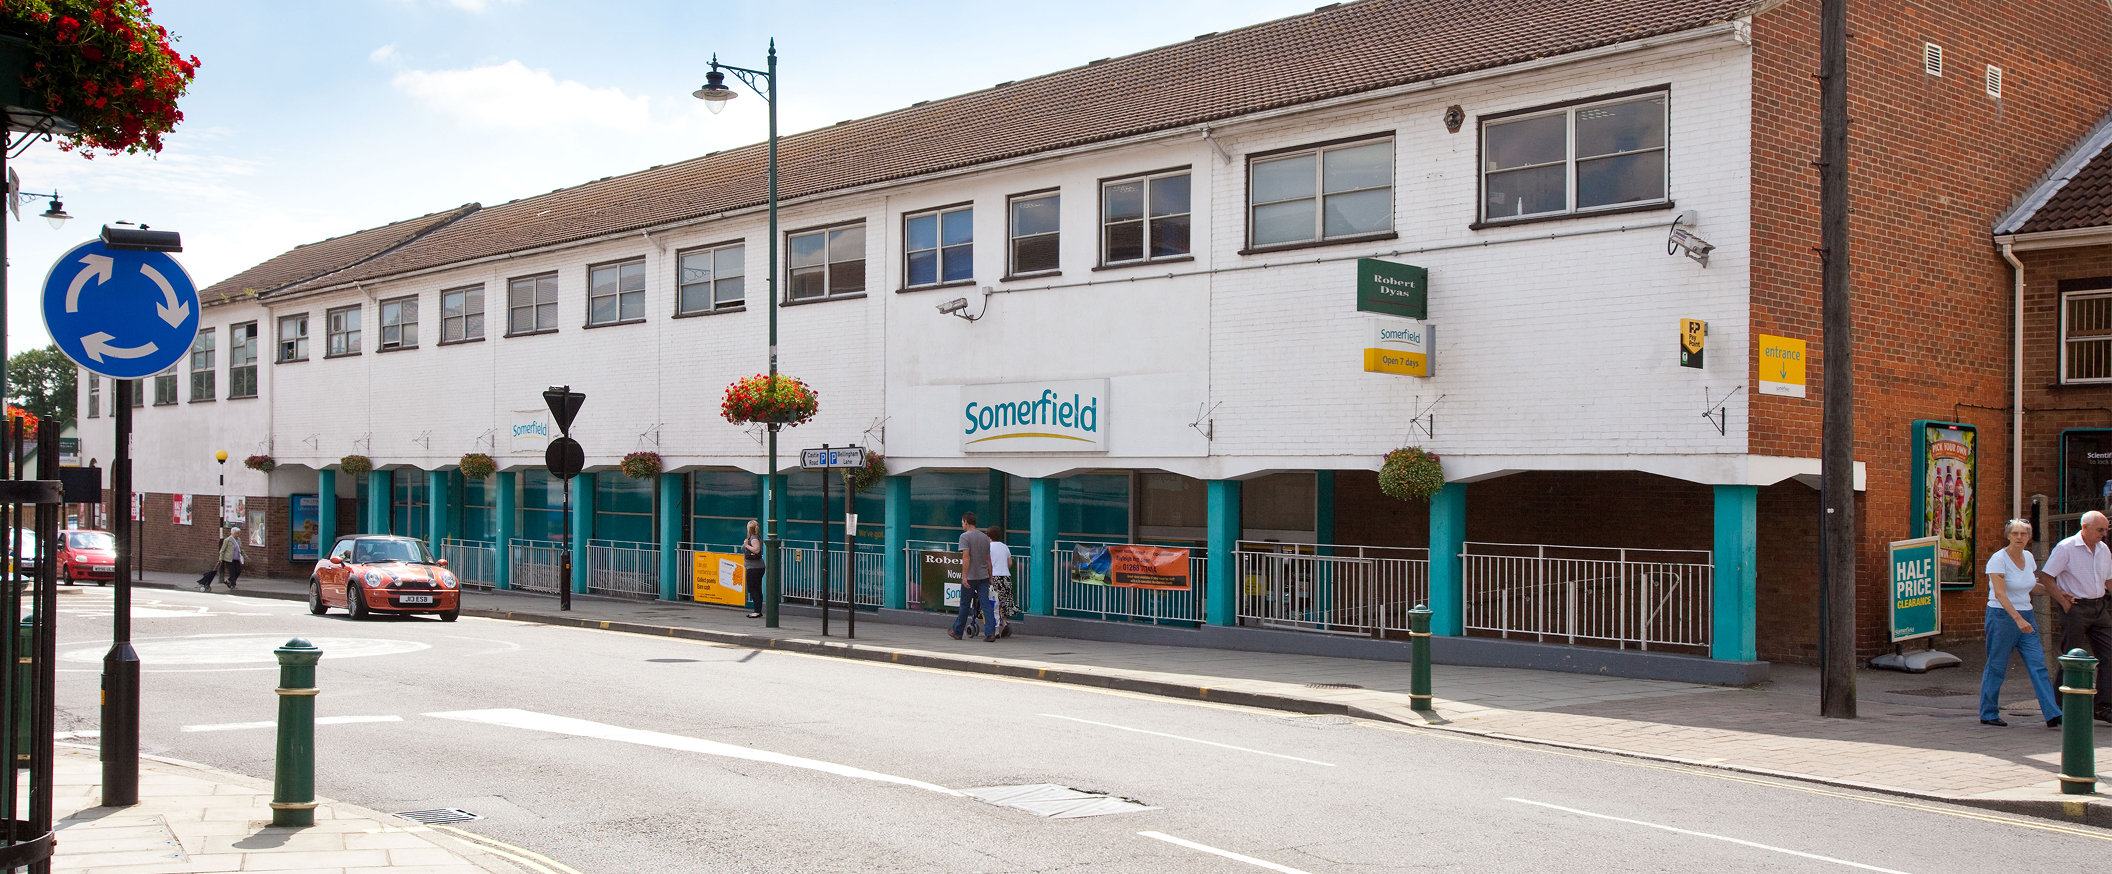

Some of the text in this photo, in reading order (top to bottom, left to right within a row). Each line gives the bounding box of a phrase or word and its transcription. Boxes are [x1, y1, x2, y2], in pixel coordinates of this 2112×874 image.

[1374, 274, 1415, 288] Robert
[1380, 286, 1409, 297] Dyas
[1381, 329, 1420, 344] Somerfield
[1689, 340, 1700, 348] Point
[1765, 347, 1800, 360] entrance
[1382, 356, 1419, 368] Open 7 days
[965, 389, 1097, 435] Somerfield
[513, 420, 547, 437] Somerfield
[1932, 443, 1943, 453] PICK
[1944, 442, 1956, 452] YOUR
[1956, 445, 1967, 456] OWN
[821, 453, 826, 464] P
[831, 453, 837, 464] P
[1897, 558, 1931, 581] HALF
[1897, 578, 1931, 599] PRICE
[1897, 596, 1931, 609] CLEARANCE
